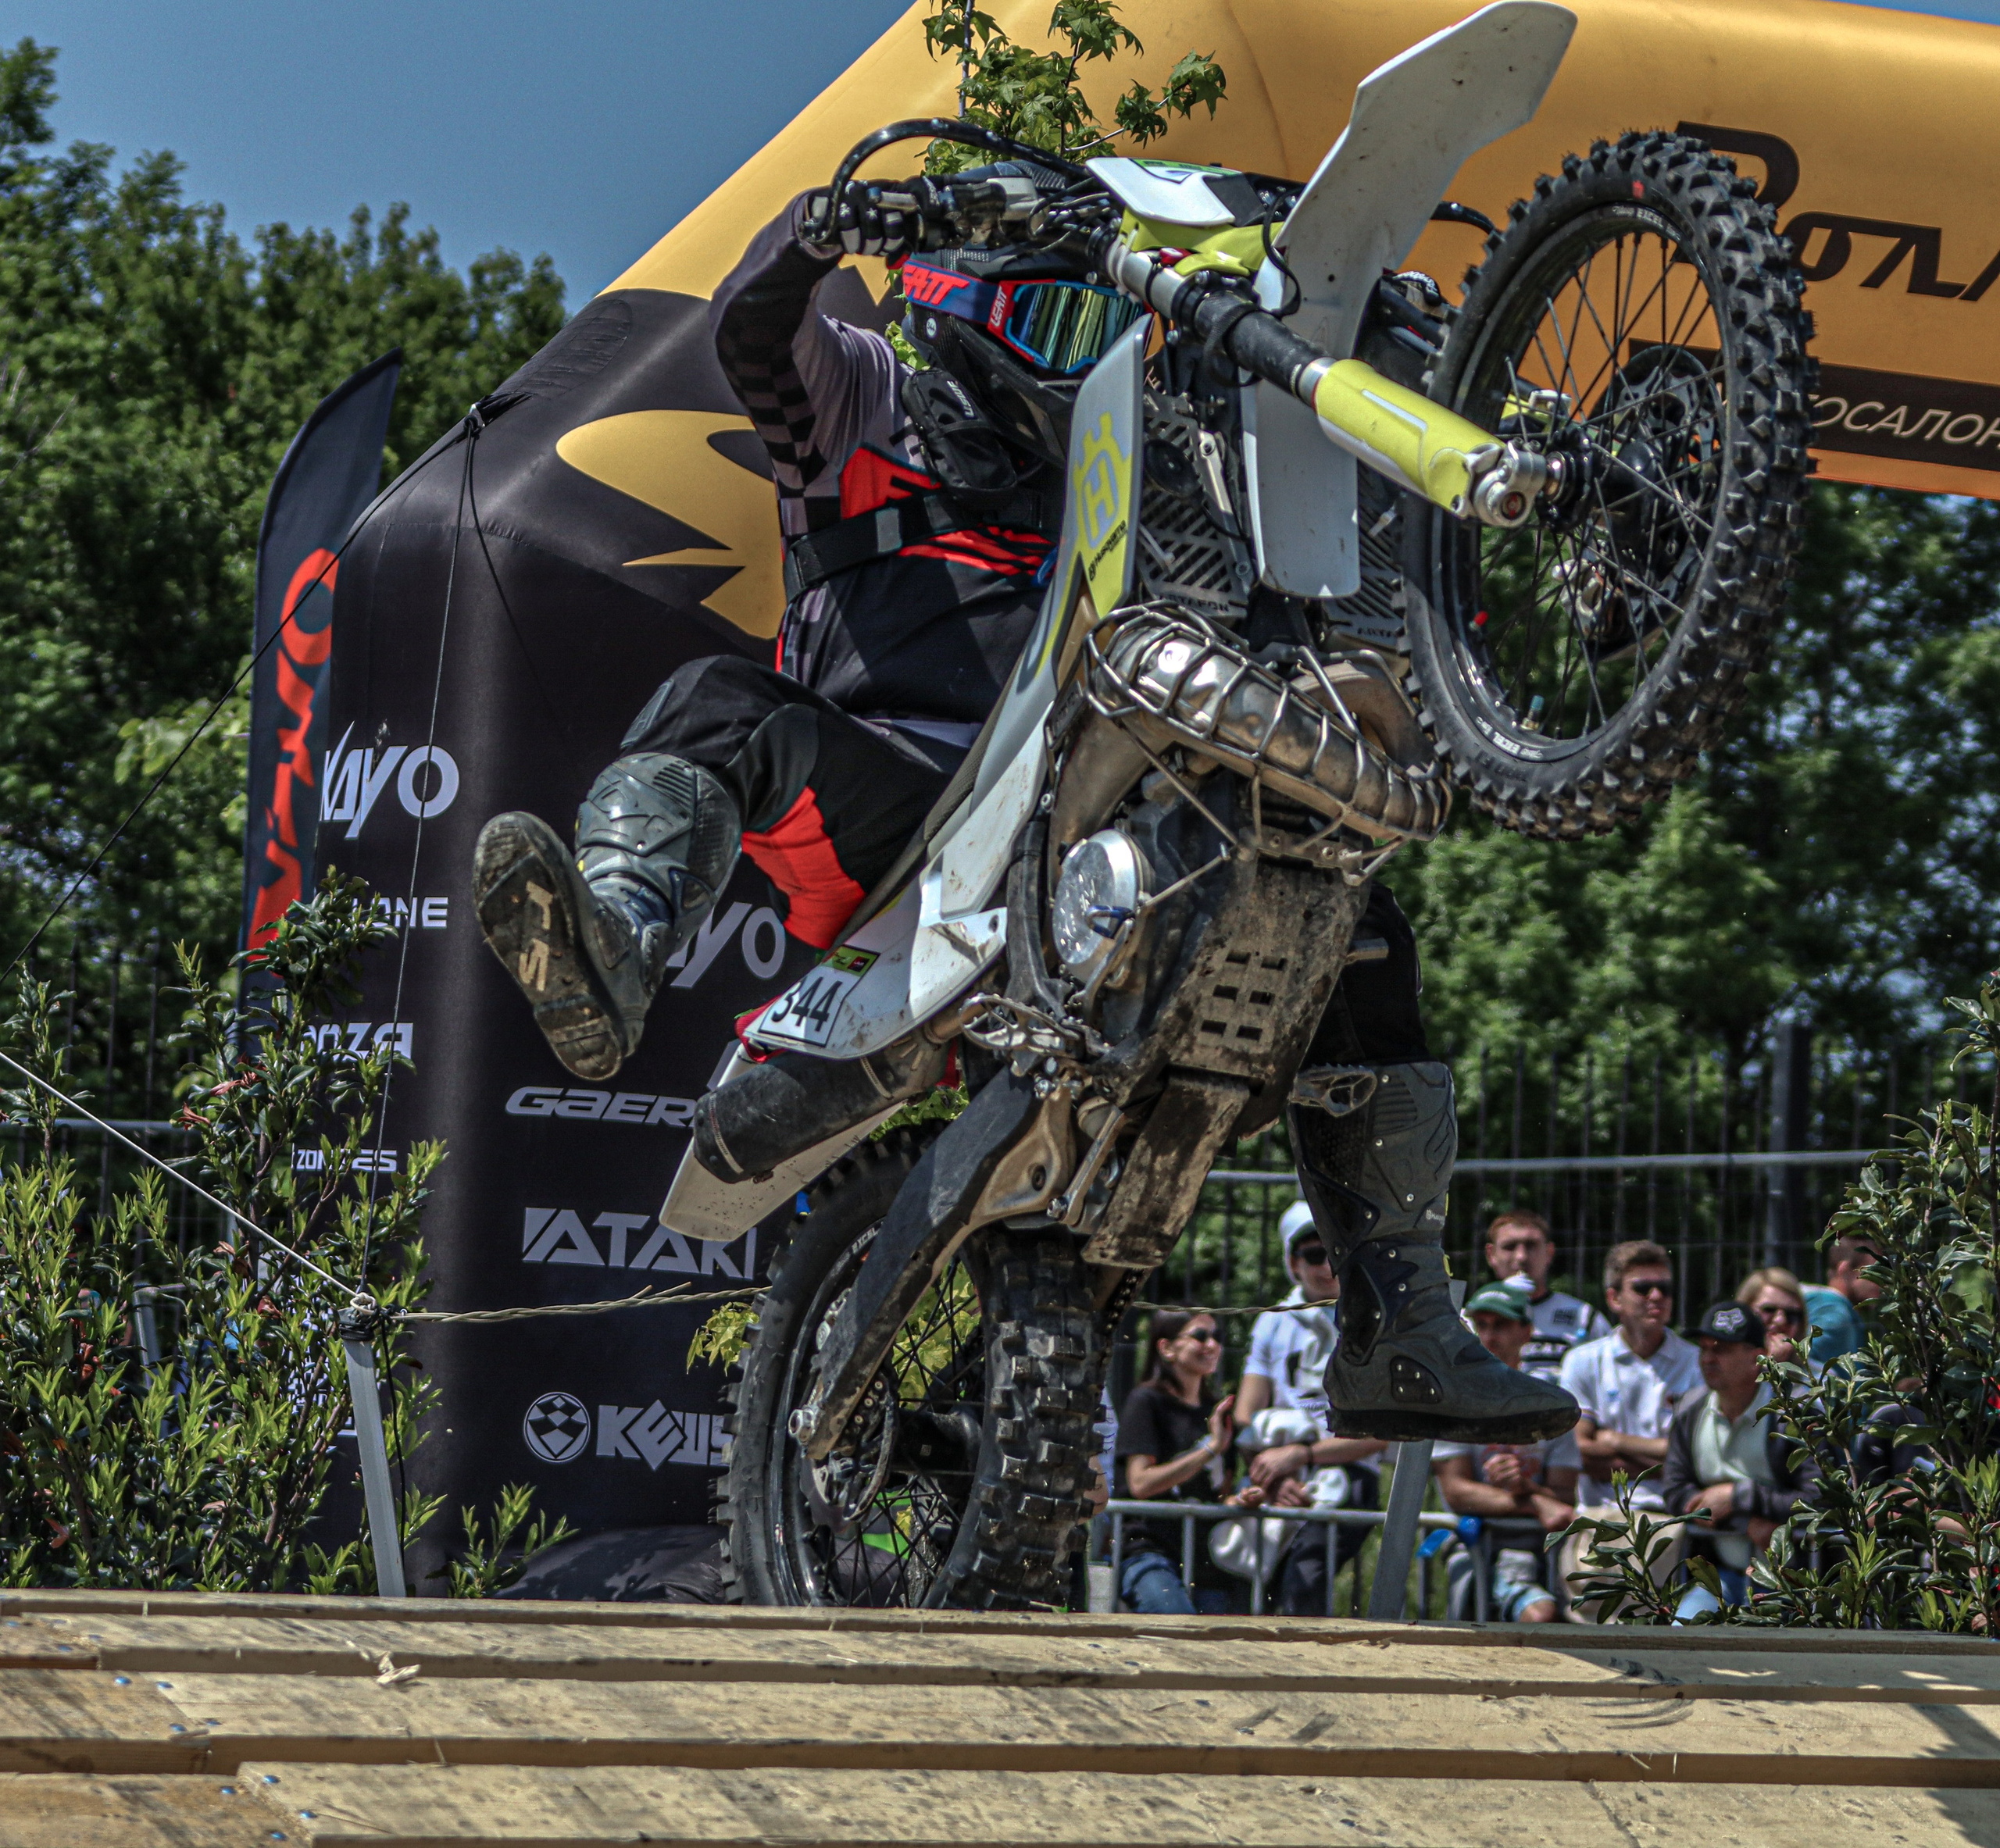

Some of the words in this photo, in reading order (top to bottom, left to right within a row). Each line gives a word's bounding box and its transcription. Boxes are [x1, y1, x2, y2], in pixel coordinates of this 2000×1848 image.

[990, 285, 1008, 327] LEATT
[1808, 394, 2000, 448] ОСАЛОН
[505, 1086, 696, 1127] GAER
